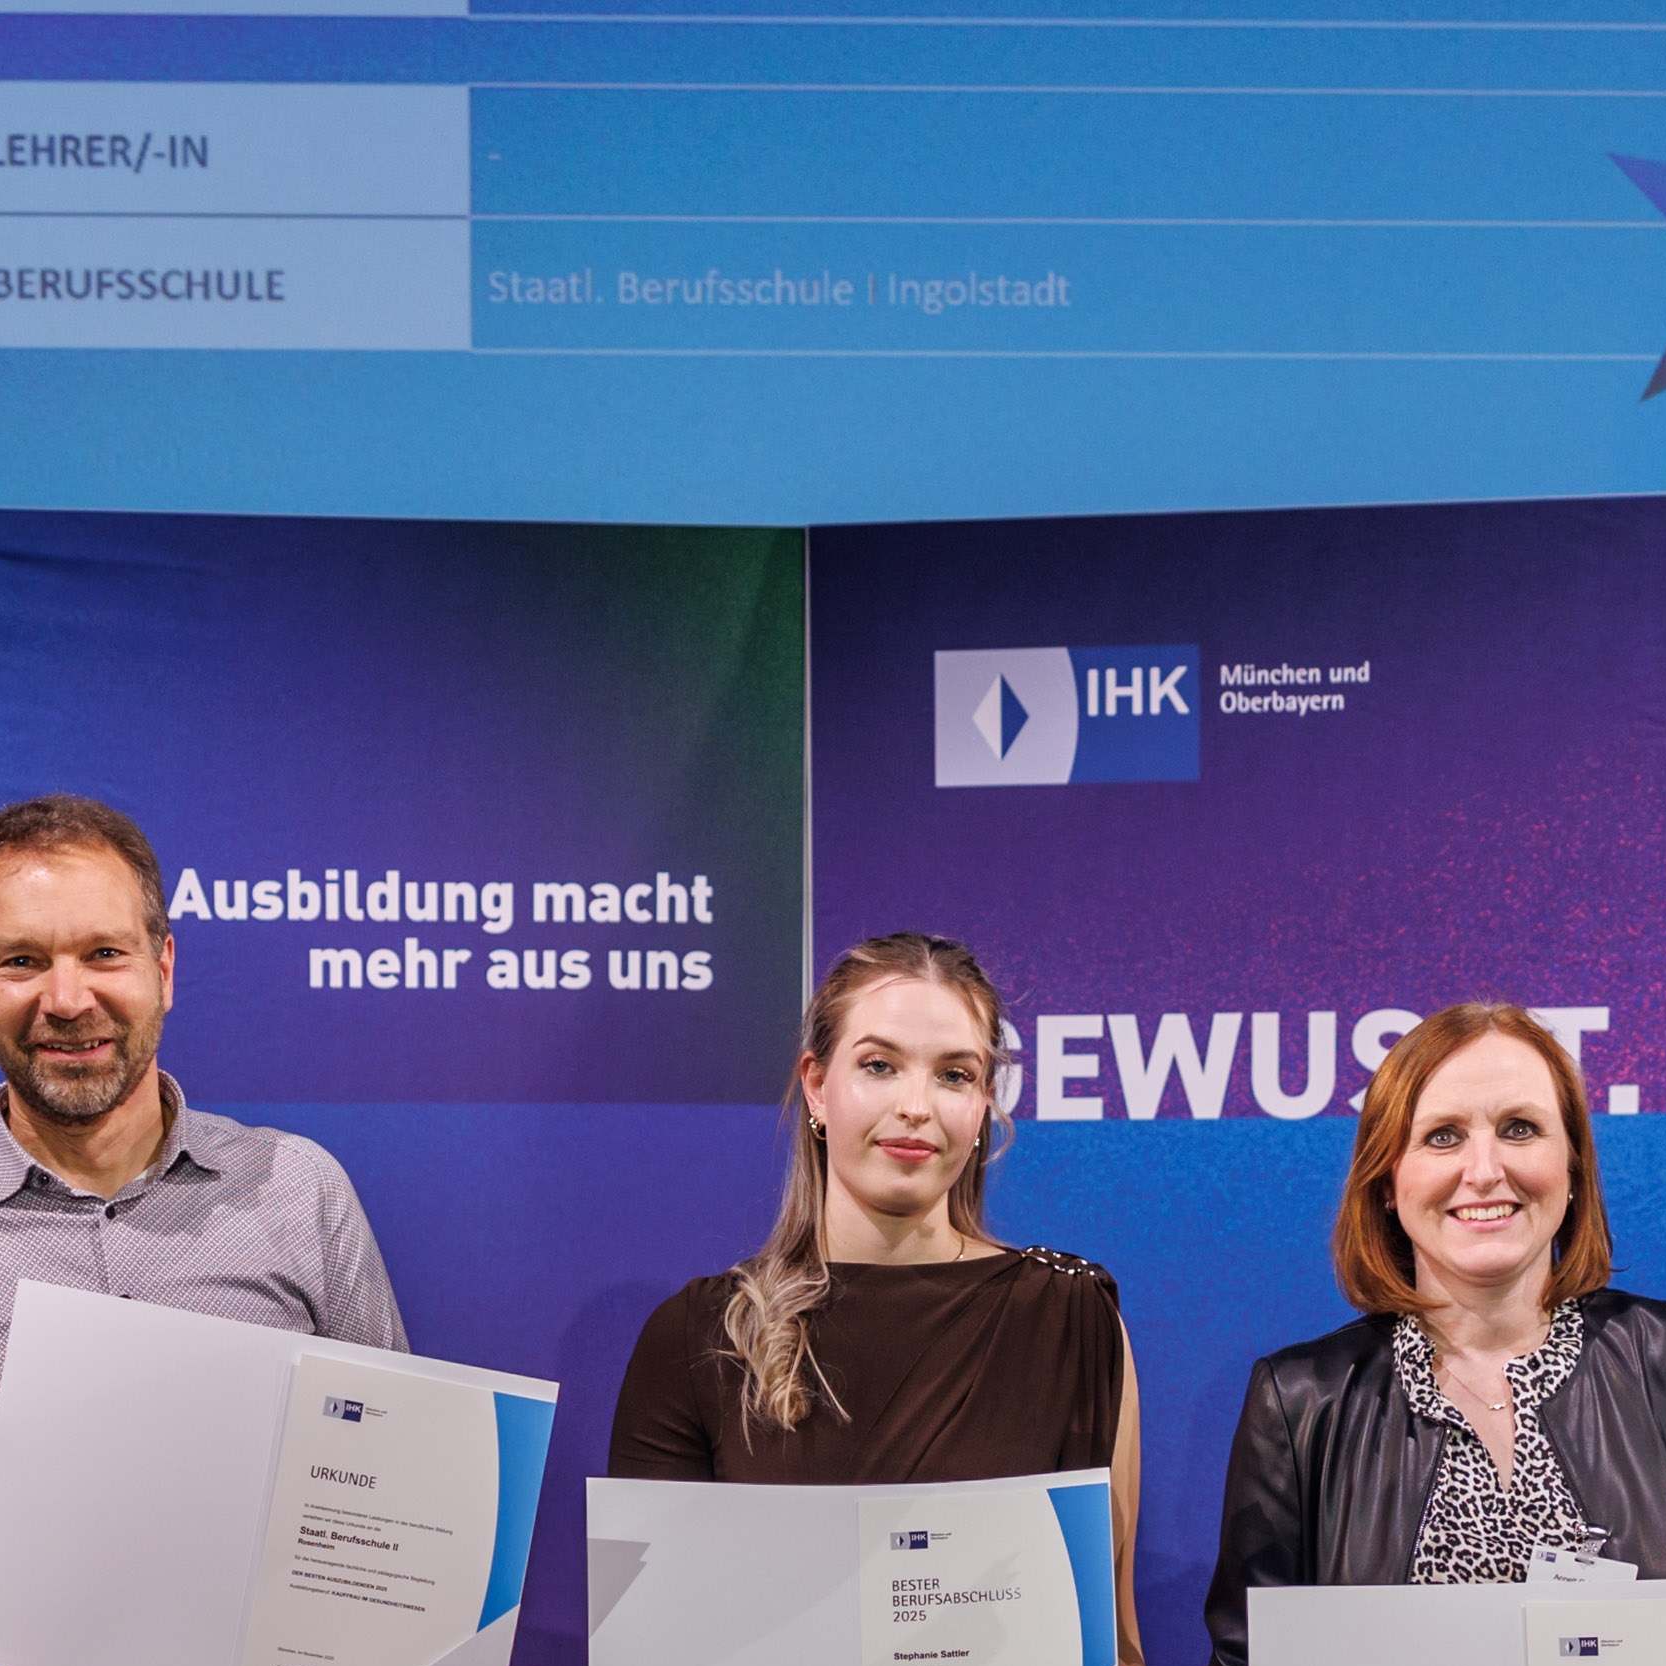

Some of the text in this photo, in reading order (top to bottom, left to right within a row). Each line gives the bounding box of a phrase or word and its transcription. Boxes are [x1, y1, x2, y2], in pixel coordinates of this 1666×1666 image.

[488, 269, 603, 303] Staatl.
[619, 270, 854, 306] Berufsschule
[889, 272, 1071, 314] Ingolstadt
[1220, 661, 1370, 686] München und
[1087, 665, 1190, 716] IHK
[1220, 691, 1345, 717] Oberbayern
[169, 868, 713, 934] Ausbildung macht
[309, 938, 713, 990] mehr aus uns
[346, 1403, 361, 1413] IHK
[310, 1465, 377, 1490] URKUNDE
[298, 1538, 334, 1550] Rosenheim
[300, 1526, 399, 1551] Staatl. Berufsschule II
[911, 1534, 927, 1542] IHK
[304, 1572, 325, 1581] BESTEN
[892, 1578, 940, 1592] BESTER
[892, 1587, 1022, 1608] BERUFSABSCHLUSS
[893, 1609, 927, 1623] 2025
[1580, 1639, 1597, 1648] IHK
[894, 1650, 969, 1661] Stephanie Sattler
